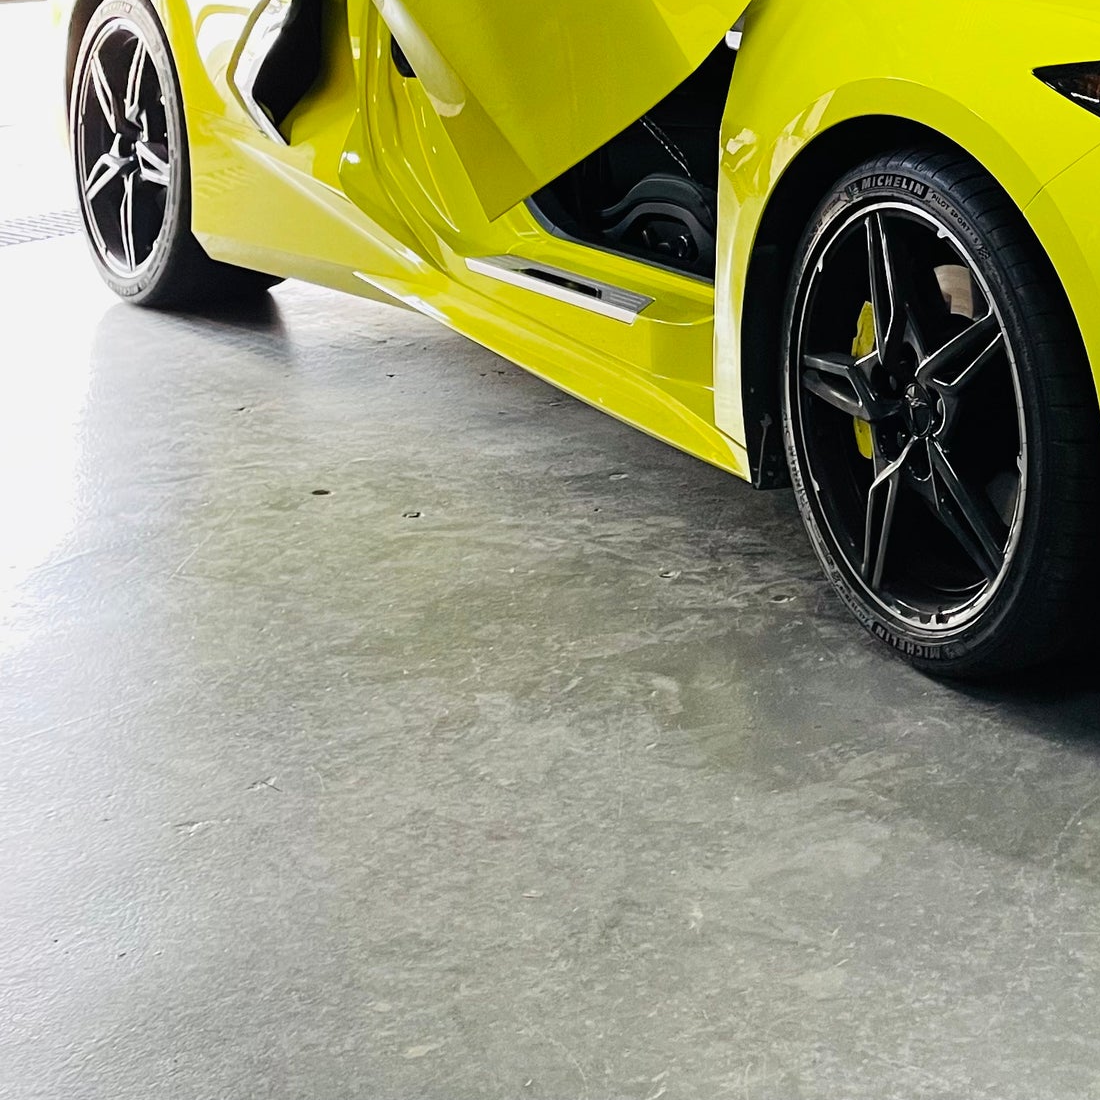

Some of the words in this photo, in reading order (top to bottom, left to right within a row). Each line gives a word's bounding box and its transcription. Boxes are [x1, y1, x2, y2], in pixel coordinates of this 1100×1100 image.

[861, 175, 925, 196] MICHELIN
[931, 193, 949, 210] PILOT
[950, 209, 972, 232] SPORT
[875, 625, 941, 659] MICHELIN
